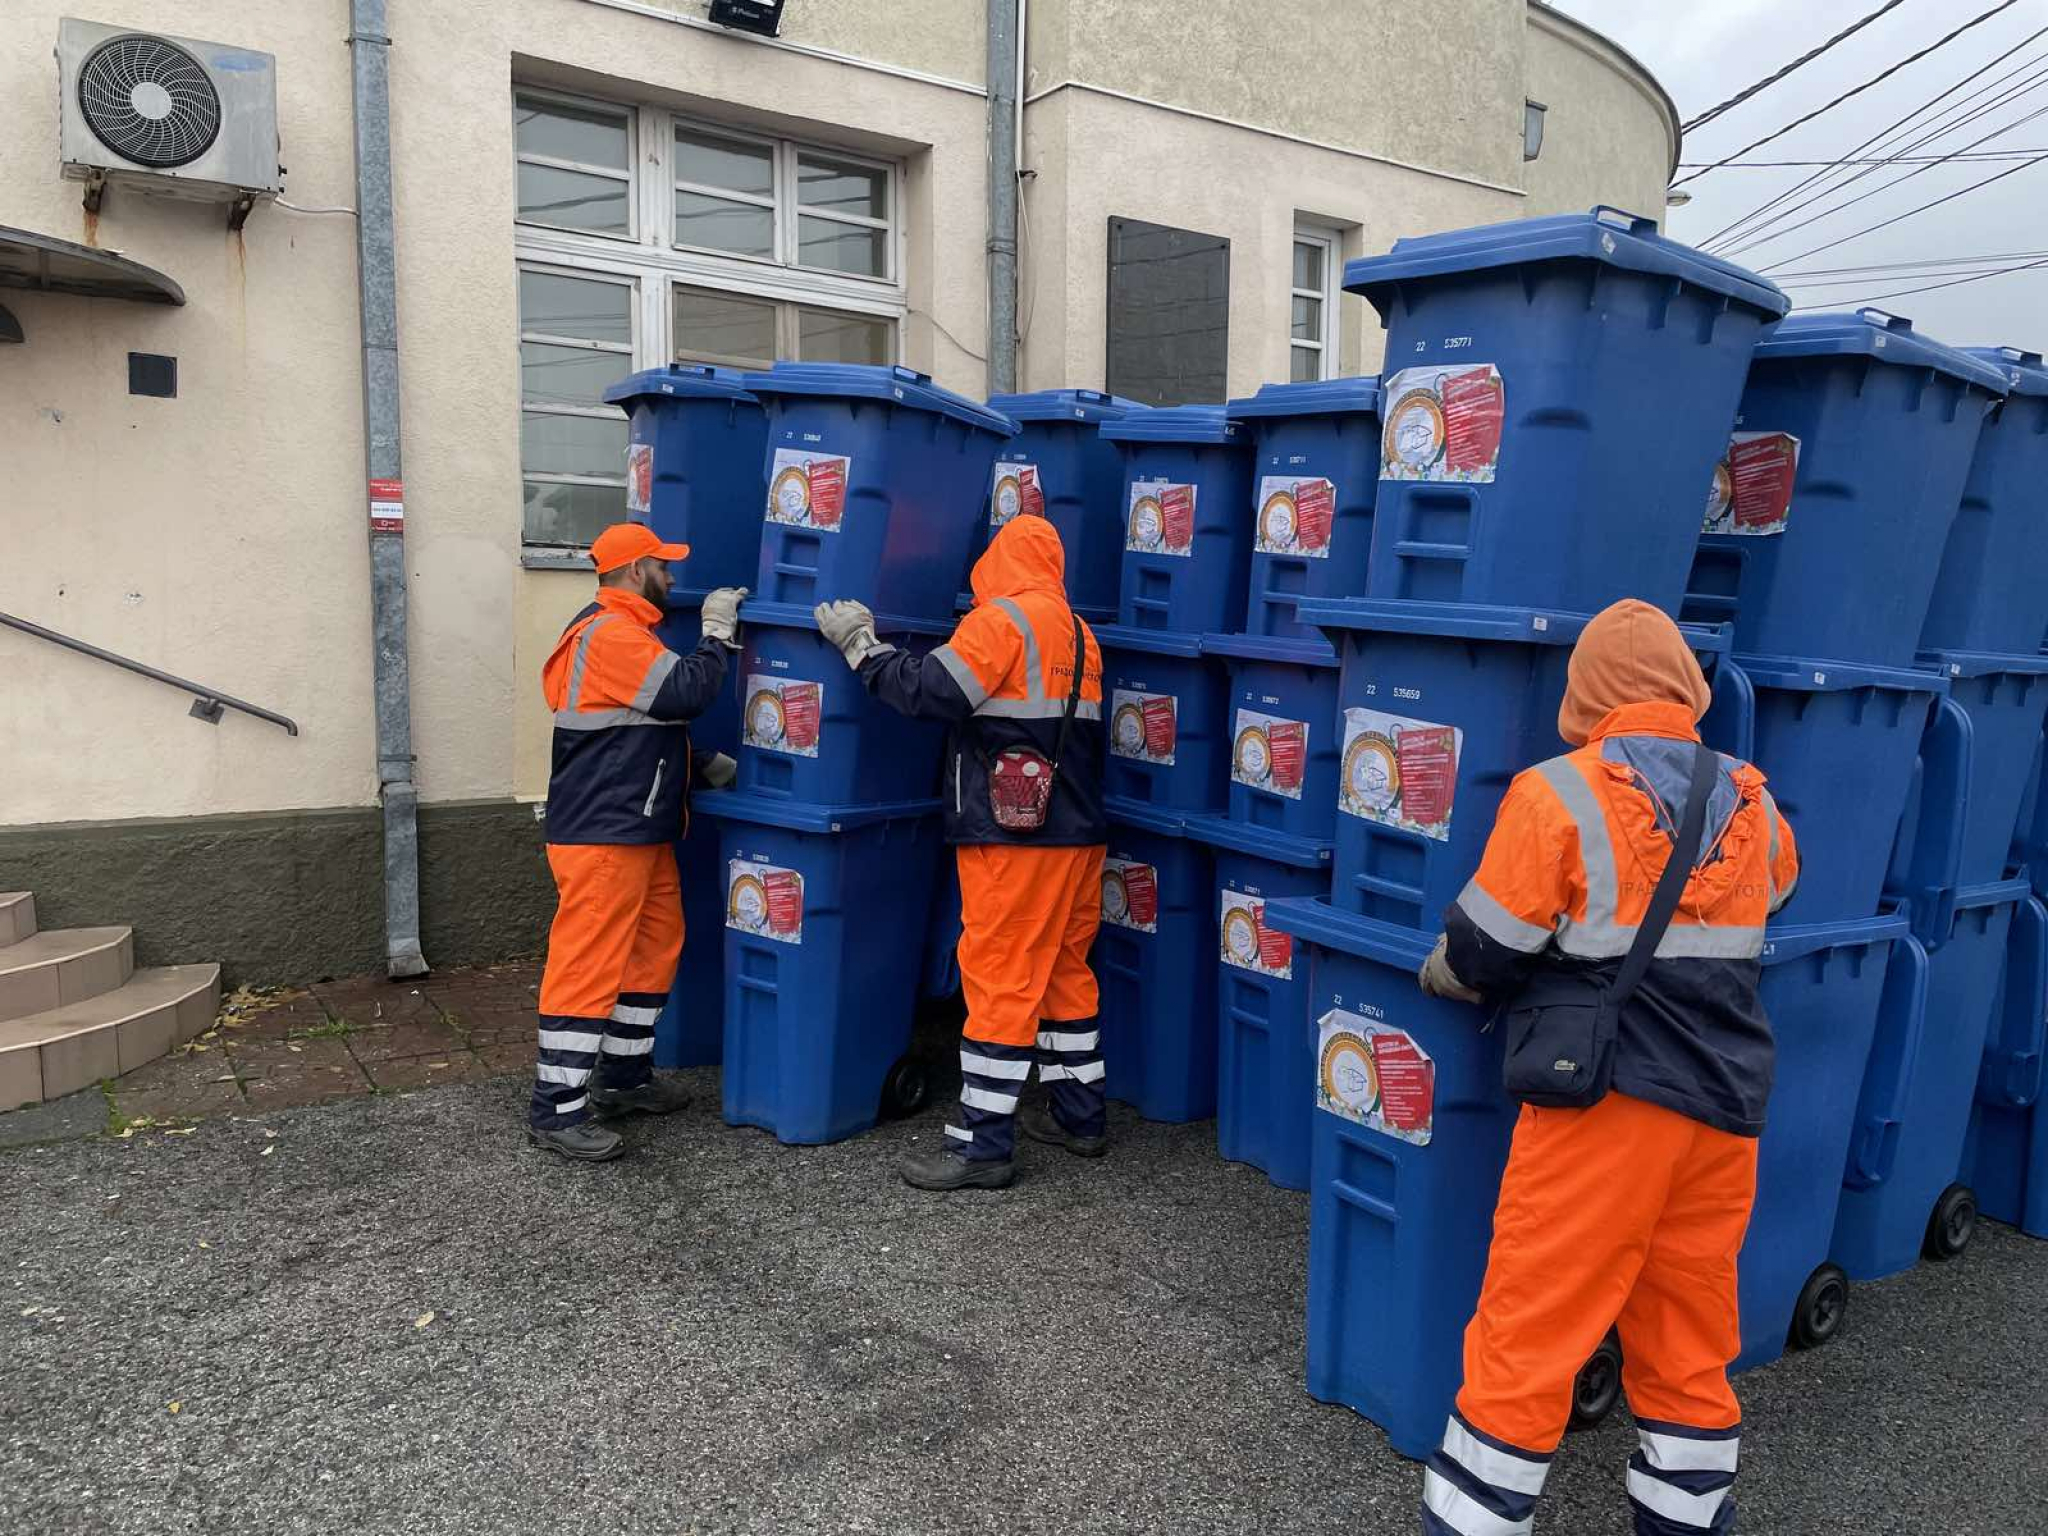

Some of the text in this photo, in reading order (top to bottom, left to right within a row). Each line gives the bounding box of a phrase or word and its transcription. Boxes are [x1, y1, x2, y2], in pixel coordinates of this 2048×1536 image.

[1416, 337, 1472, 352] 22 535771
[1366, 684, 1420, 700] 22 535659
[1334, 993, 1384, 1019] 22 535741
